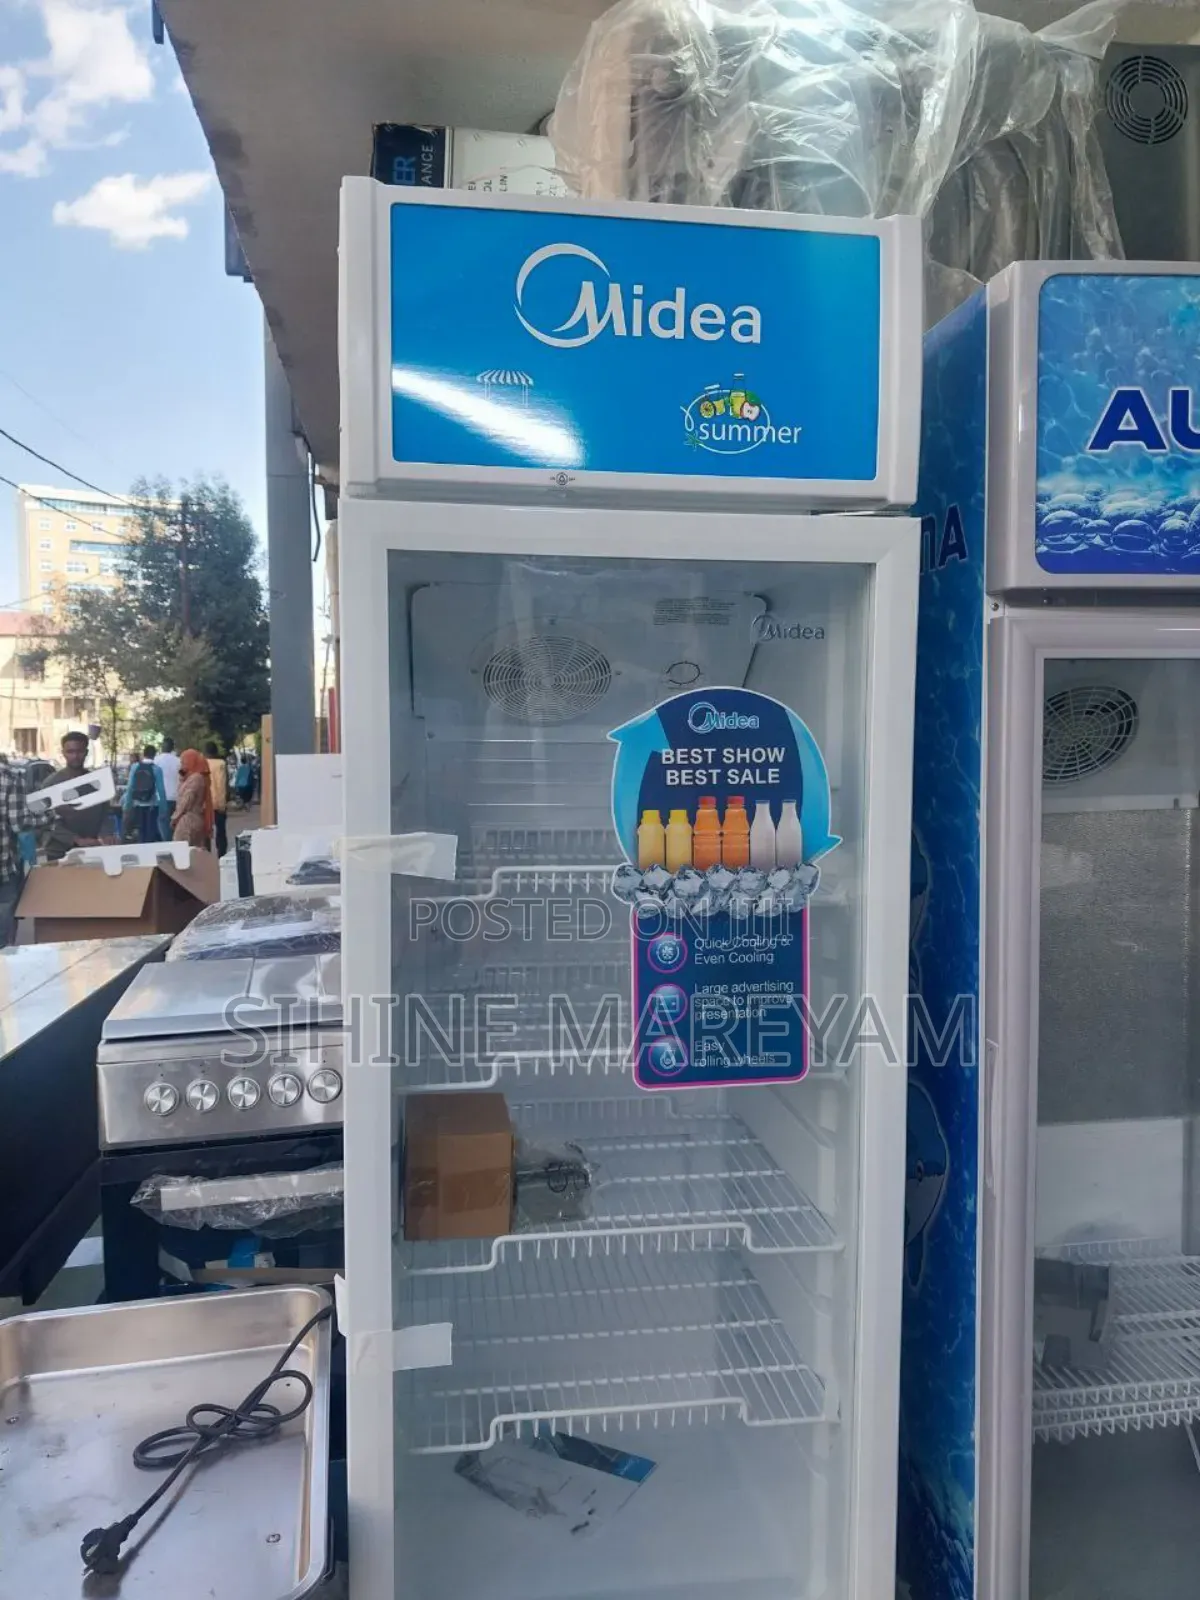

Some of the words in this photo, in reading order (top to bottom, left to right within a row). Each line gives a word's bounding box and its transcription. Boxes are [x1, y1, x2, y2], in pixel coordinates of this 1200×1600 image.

[513, 242, 762, 348] Midea
[699, 423, 802, 444] summer
[752, 614, 826, 641] Midea
[687, 702, 760, 734] Midea
[661, 748, 717, 765] BEST
[722, 747, 786, 764] SHOW
[665, 769, 721, 786] BEST
[727, 768, 780, 784] SALE
[694, 937, 728, 951] Quick
[733, 935, 777, 950] Cooling
[694, 953, 725, 965] Even
[728, 951, 775, 965] Cooling
[694, 982, 729, 996] Large
[731, 979, 794, 994] advertising
[733, 994, 745, 1006] to
[694, 1039, 726, 1054] Easy
